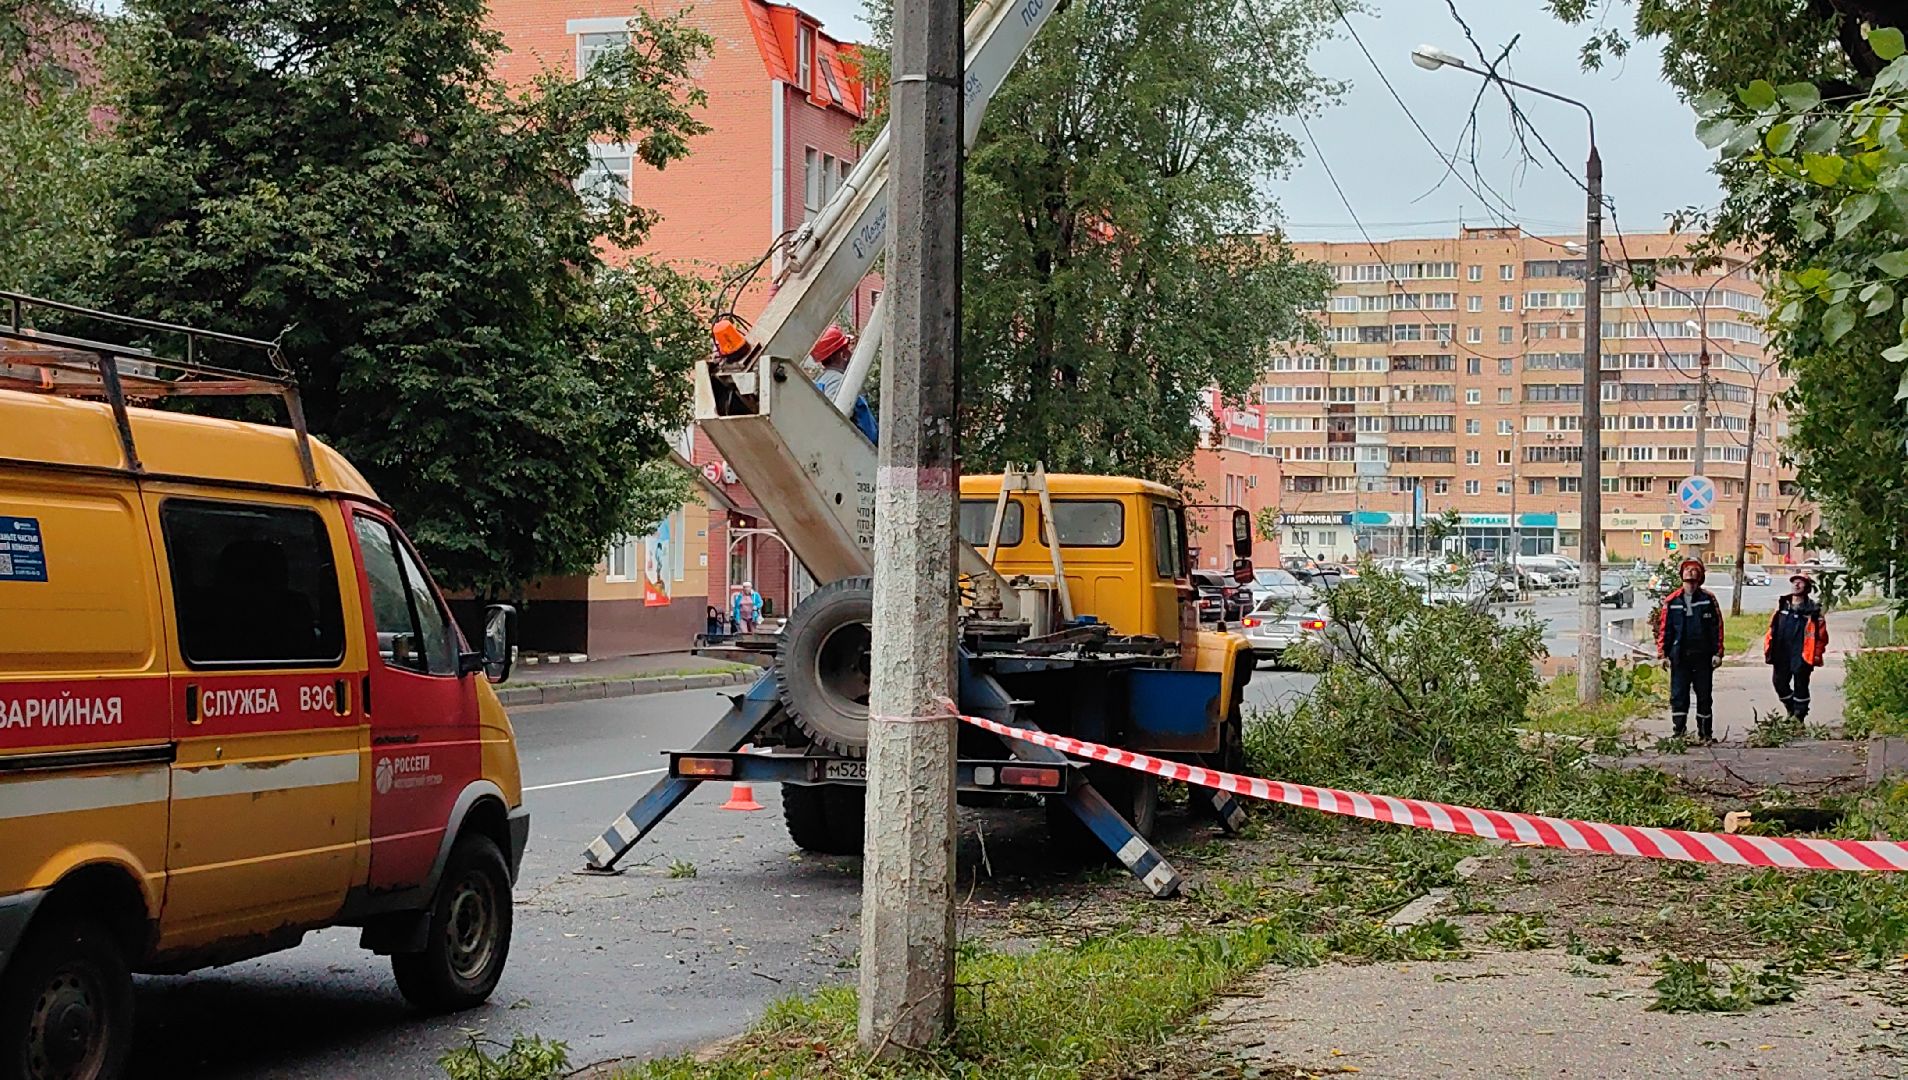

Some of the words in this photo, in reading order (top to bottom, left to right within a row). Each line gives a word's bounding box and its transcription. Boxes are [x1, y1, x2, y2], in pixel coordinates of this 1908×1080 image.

[1286, 514, 1343, 525] ГАЗПРОМБАНК
[202, 688, 280, 717] СЛУЖБА
[299, 685, 334, 711] ВЭС
[394, 755, 430, 774] РОССЕТИ
